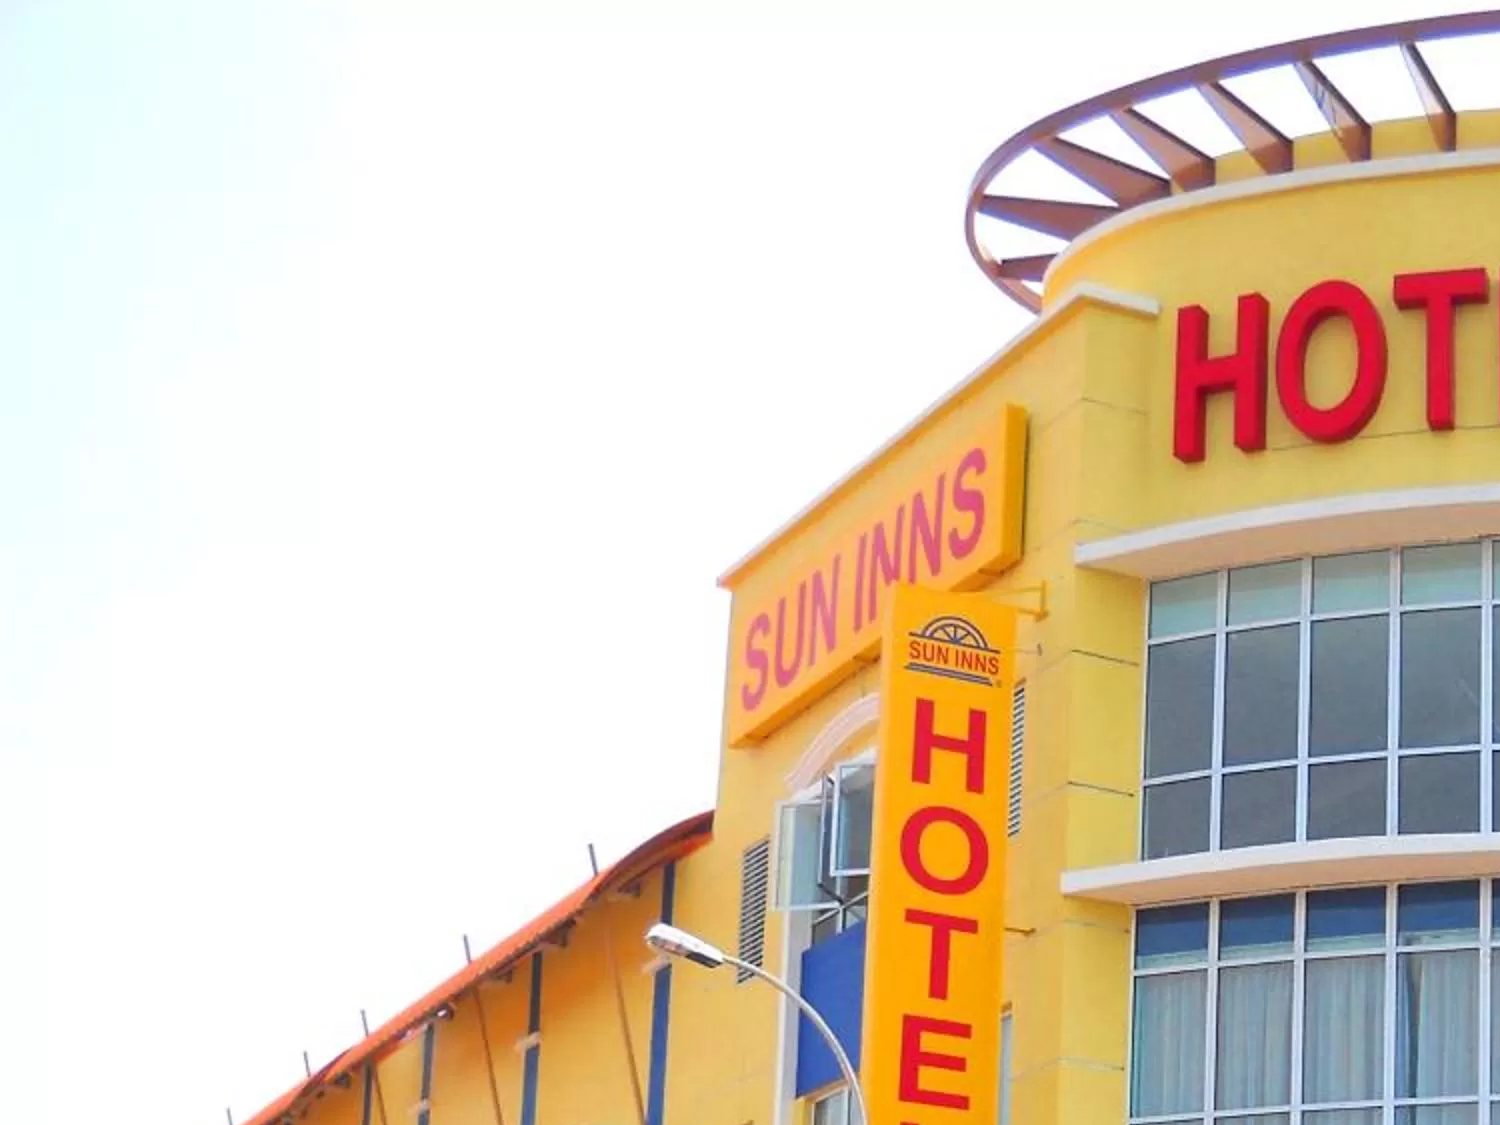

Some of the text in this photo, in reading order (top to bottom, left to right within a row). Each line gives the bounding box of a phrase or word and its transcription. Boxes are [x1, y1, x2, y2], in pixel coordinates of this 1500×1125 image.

[741, 447, 987, 712] SUN INNS
[909, 640, 1000, 675] SUN INNS
